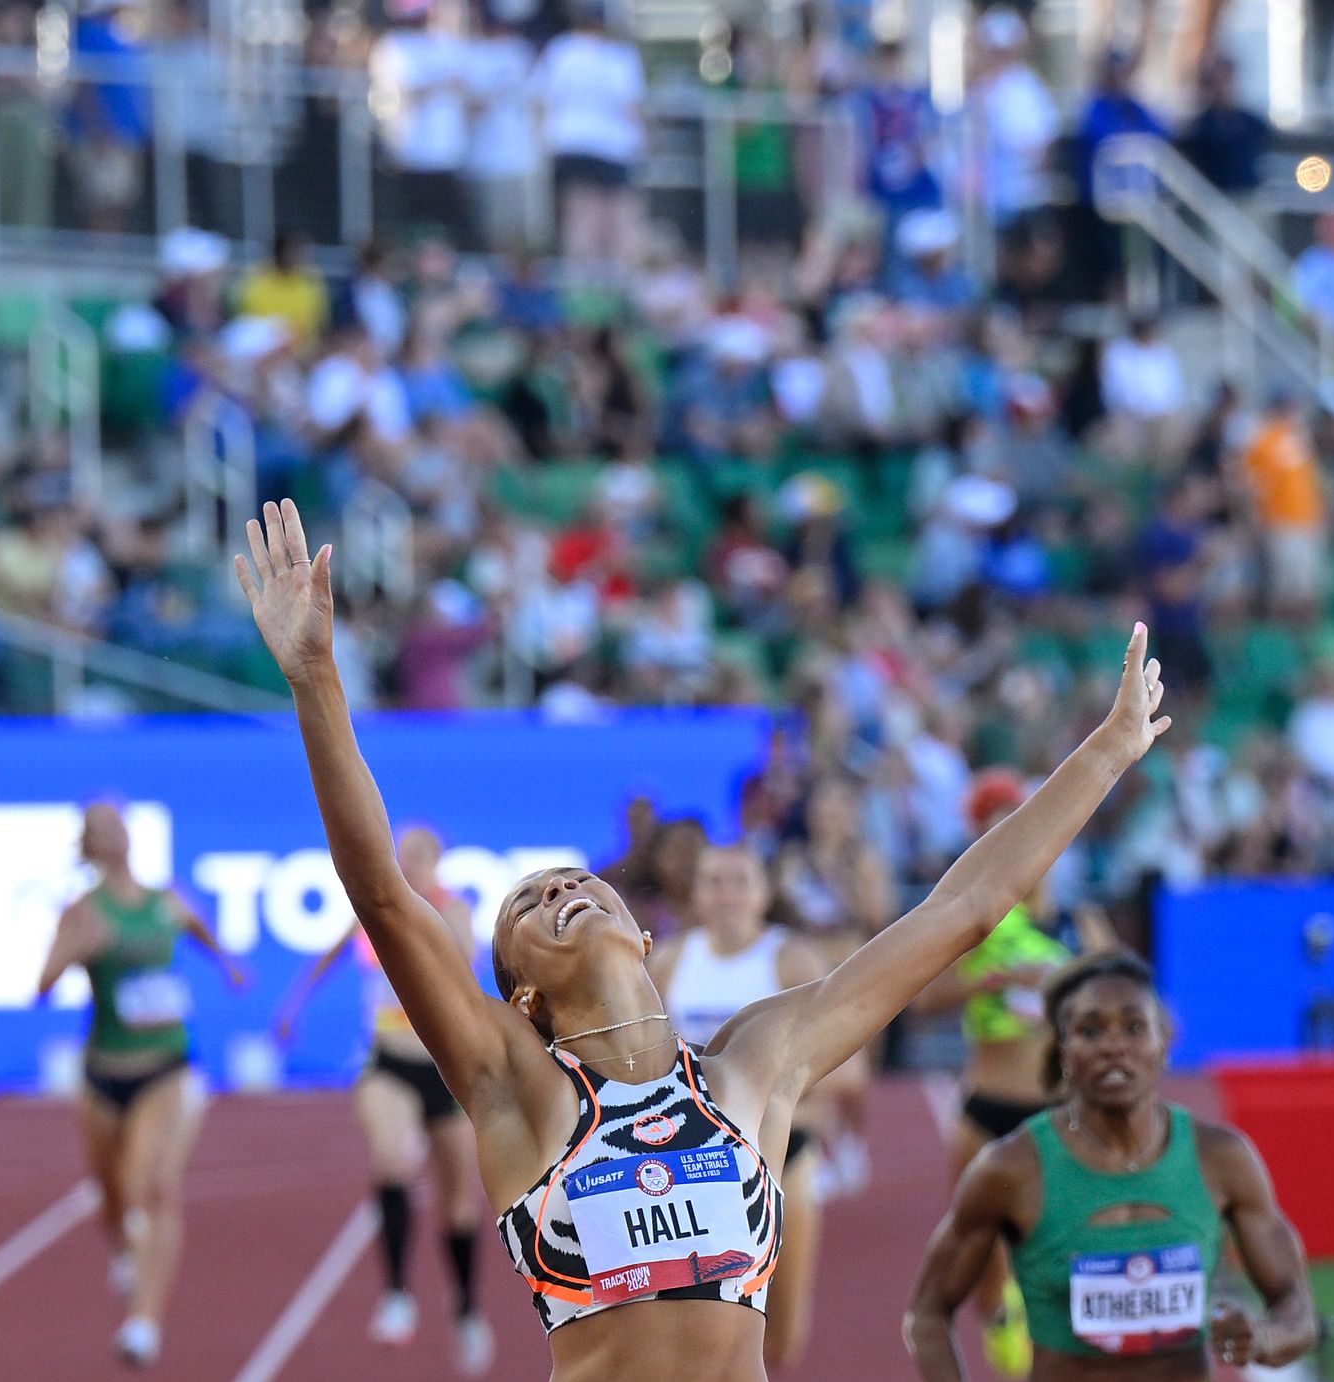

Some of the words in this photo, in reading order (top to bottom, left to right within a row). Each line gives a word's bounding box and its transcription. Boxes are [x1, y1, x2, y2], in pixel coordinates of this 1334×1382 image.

[680, 1154, 694, 1164] U.S.
[697, 1151, 727, 1162] OLYMPIC
[683, 1163, 703, 1173] TEAM
[705, 1159, 729, 1170] TRIALS
[591, 1170, 625, 1186] USATF
[686, 1172, 702, 1180] TRACK
[707, 1169, 721, 1178] FIELD
[623, 1199, 709, 1248] HALL
[599, 1265, 651, 1291] TRACKTOWN
[627, 1277, 650, 1292] 2024
